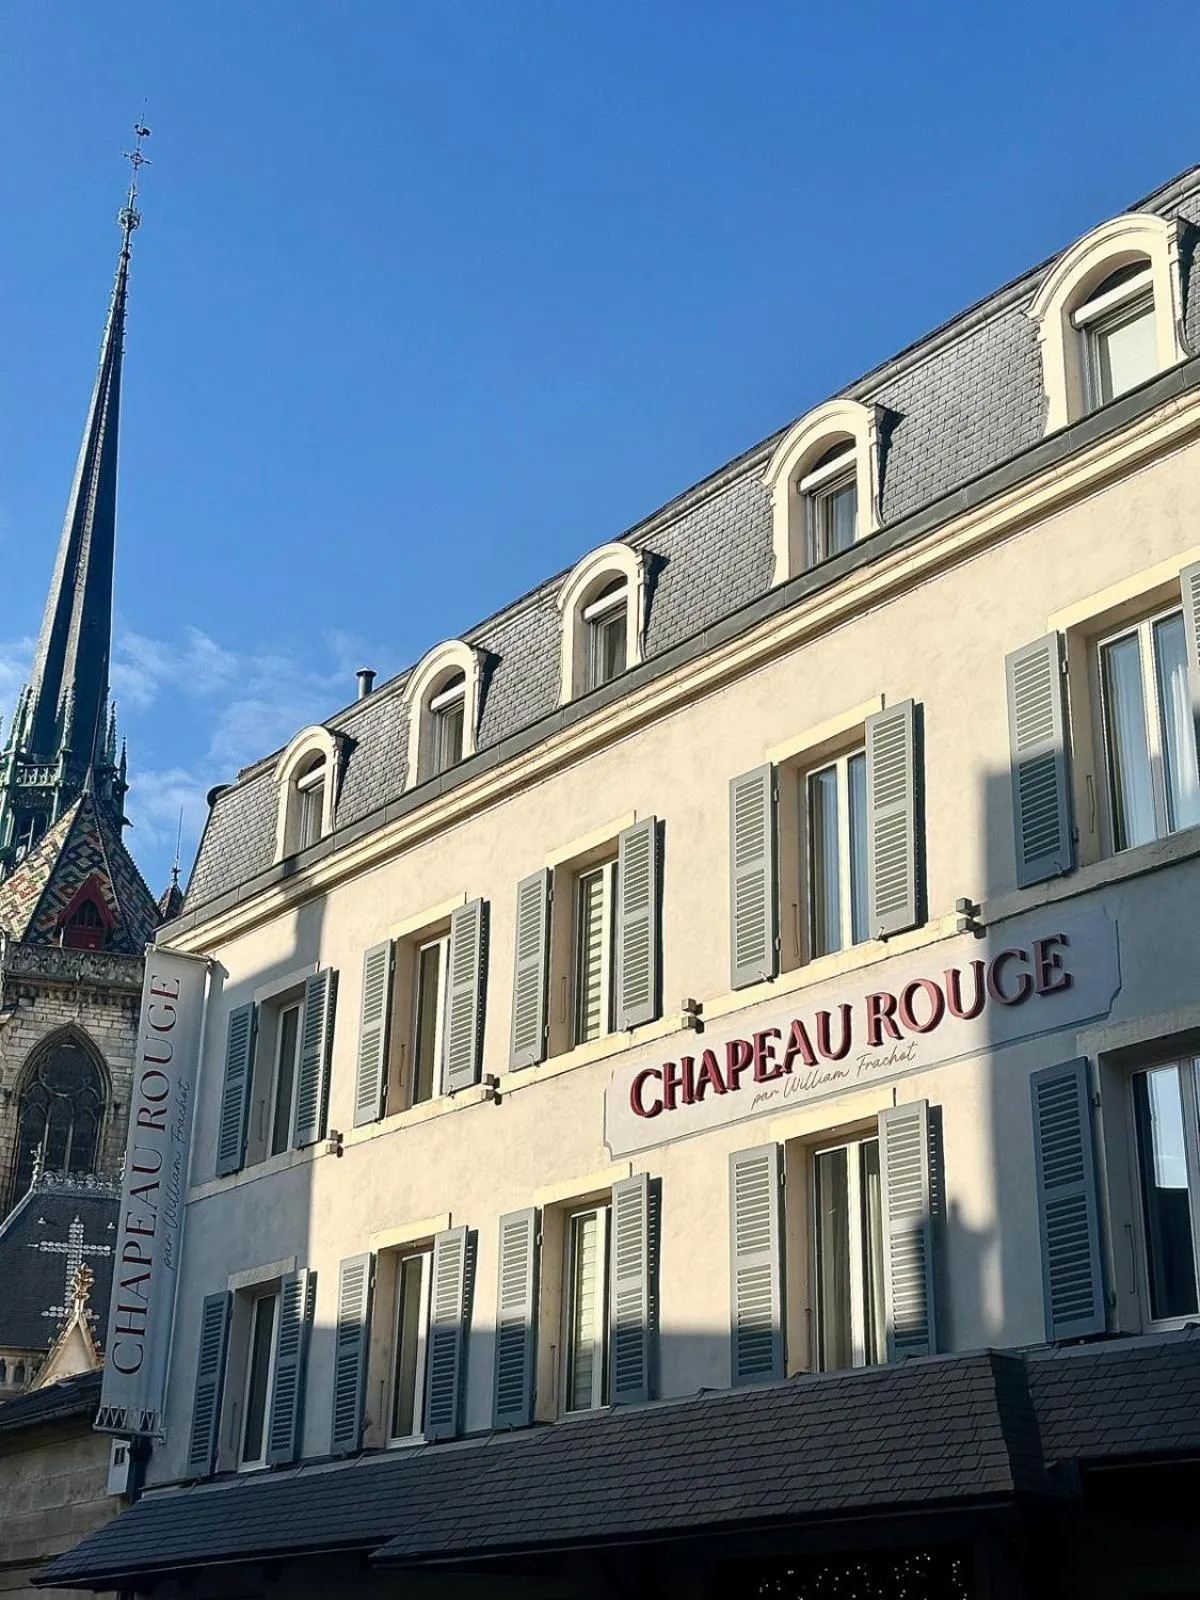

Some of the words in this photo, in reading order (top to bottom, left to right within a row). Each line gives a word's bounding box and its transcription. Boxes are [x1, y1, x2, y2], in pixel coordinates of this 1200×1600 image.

[136, 974, 180, 1131] ROUGE
[630, 1004, 853, 1118] CHAPEAU
[865, 933, 1074, 1046] ROUGE
[751, 1088, 780, 1110] par
[783, 1068, 850, 1098] William
[856, 1041, 918, 1077] Frachot
[163, 1151, 182, 1229] William
[111, 1145, 164, 1376] CHAPEAU
[163, 1233, 176, 1271] par
